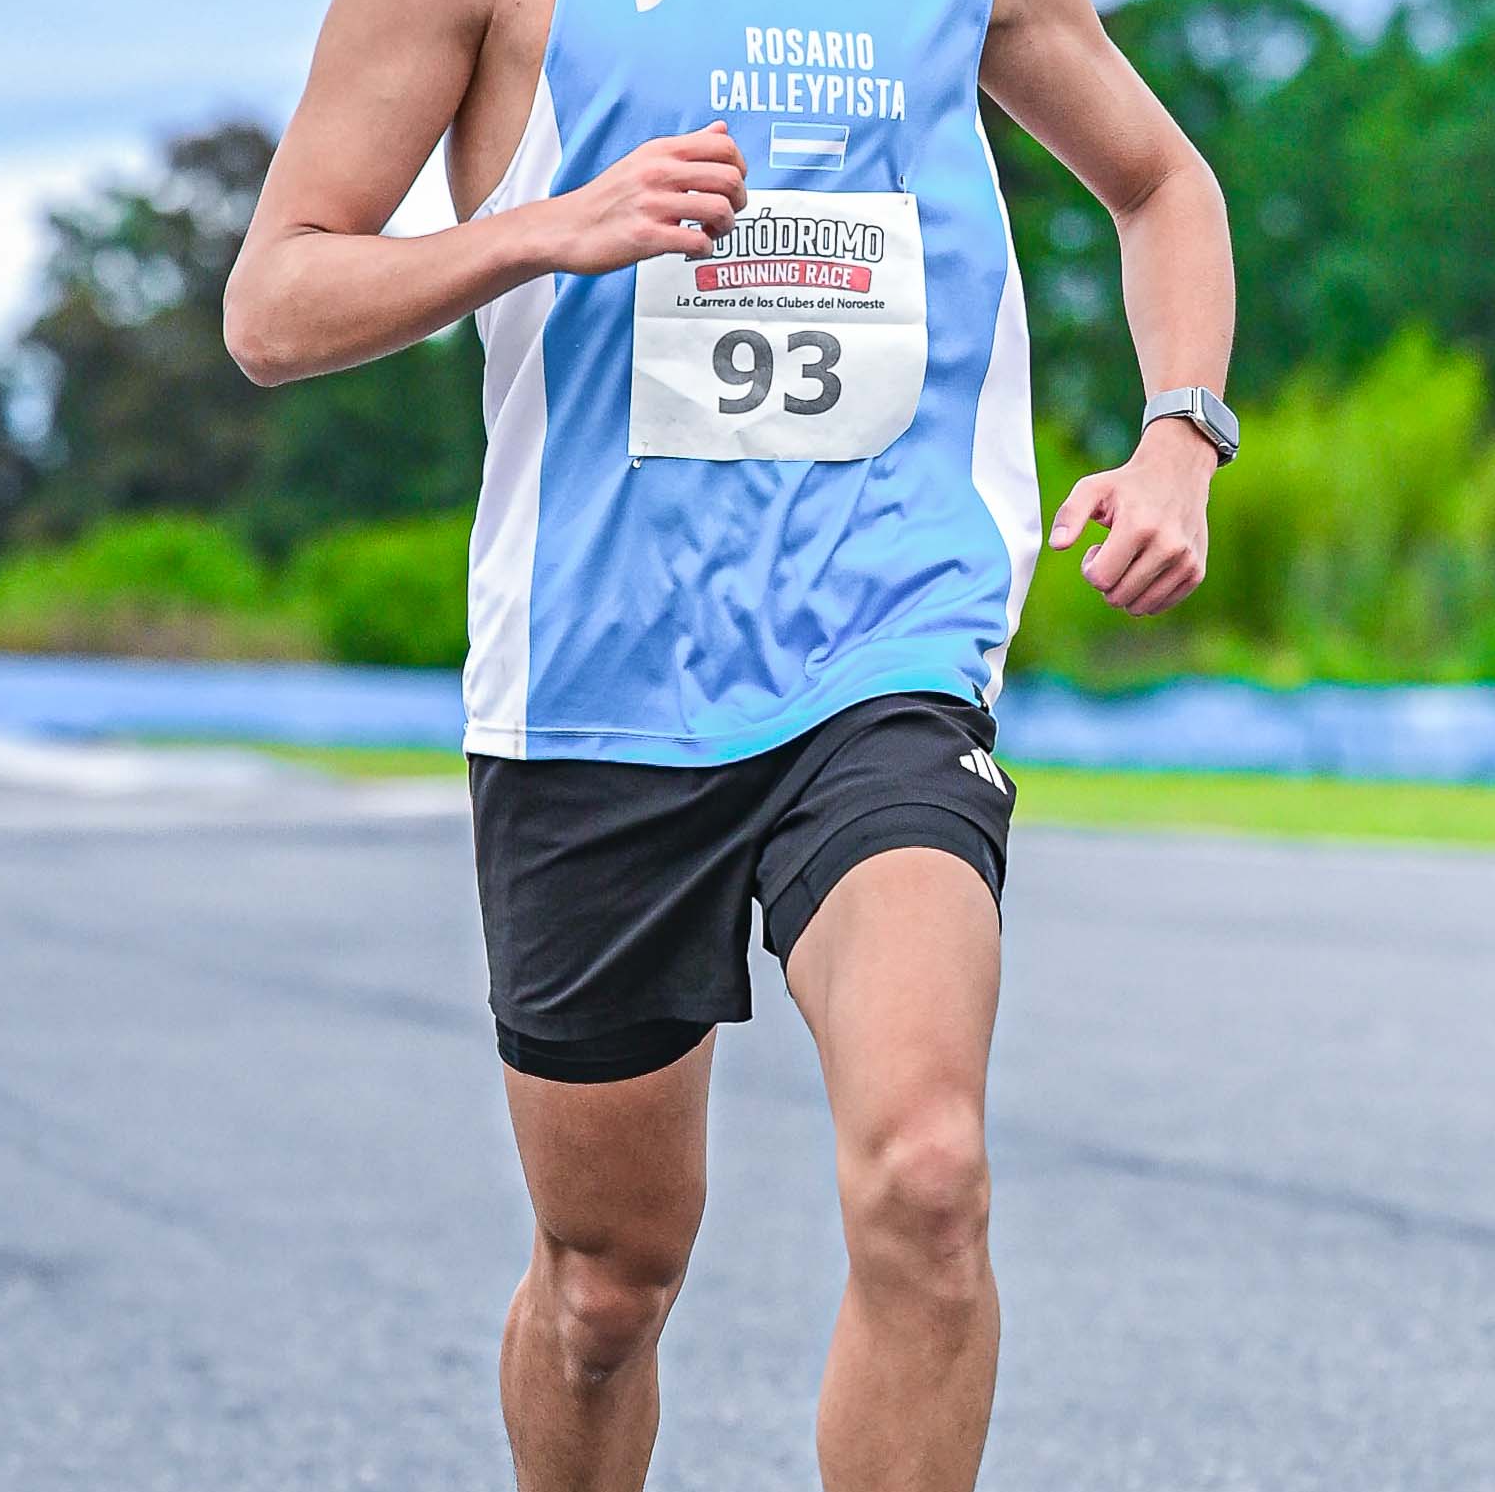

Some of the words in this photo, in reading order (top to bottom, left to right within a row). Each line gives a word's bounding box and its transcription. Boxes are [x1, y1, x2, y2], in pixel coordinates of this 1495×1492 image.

[744, 26, 875, 71] ROSARIO
[710, 69, 905, 121] CALLEYPISTA
[680, 207, 884, 263] UTÓDROMO
[716, 262, 800, 288] RUNNING
[805, 264, 853, 289] RACE
[676, 295, 690, 307] La
[693, 295, 736, 308] Carrera
[739, 296, 754, 308] de
[757, 296, 773, 308] los
[776, 296, 814, 309] Clubes
[818, 297, 834, 309] del
[837, 297, 885, 310] Noroeste
[712, 328, 842, 416] 93
